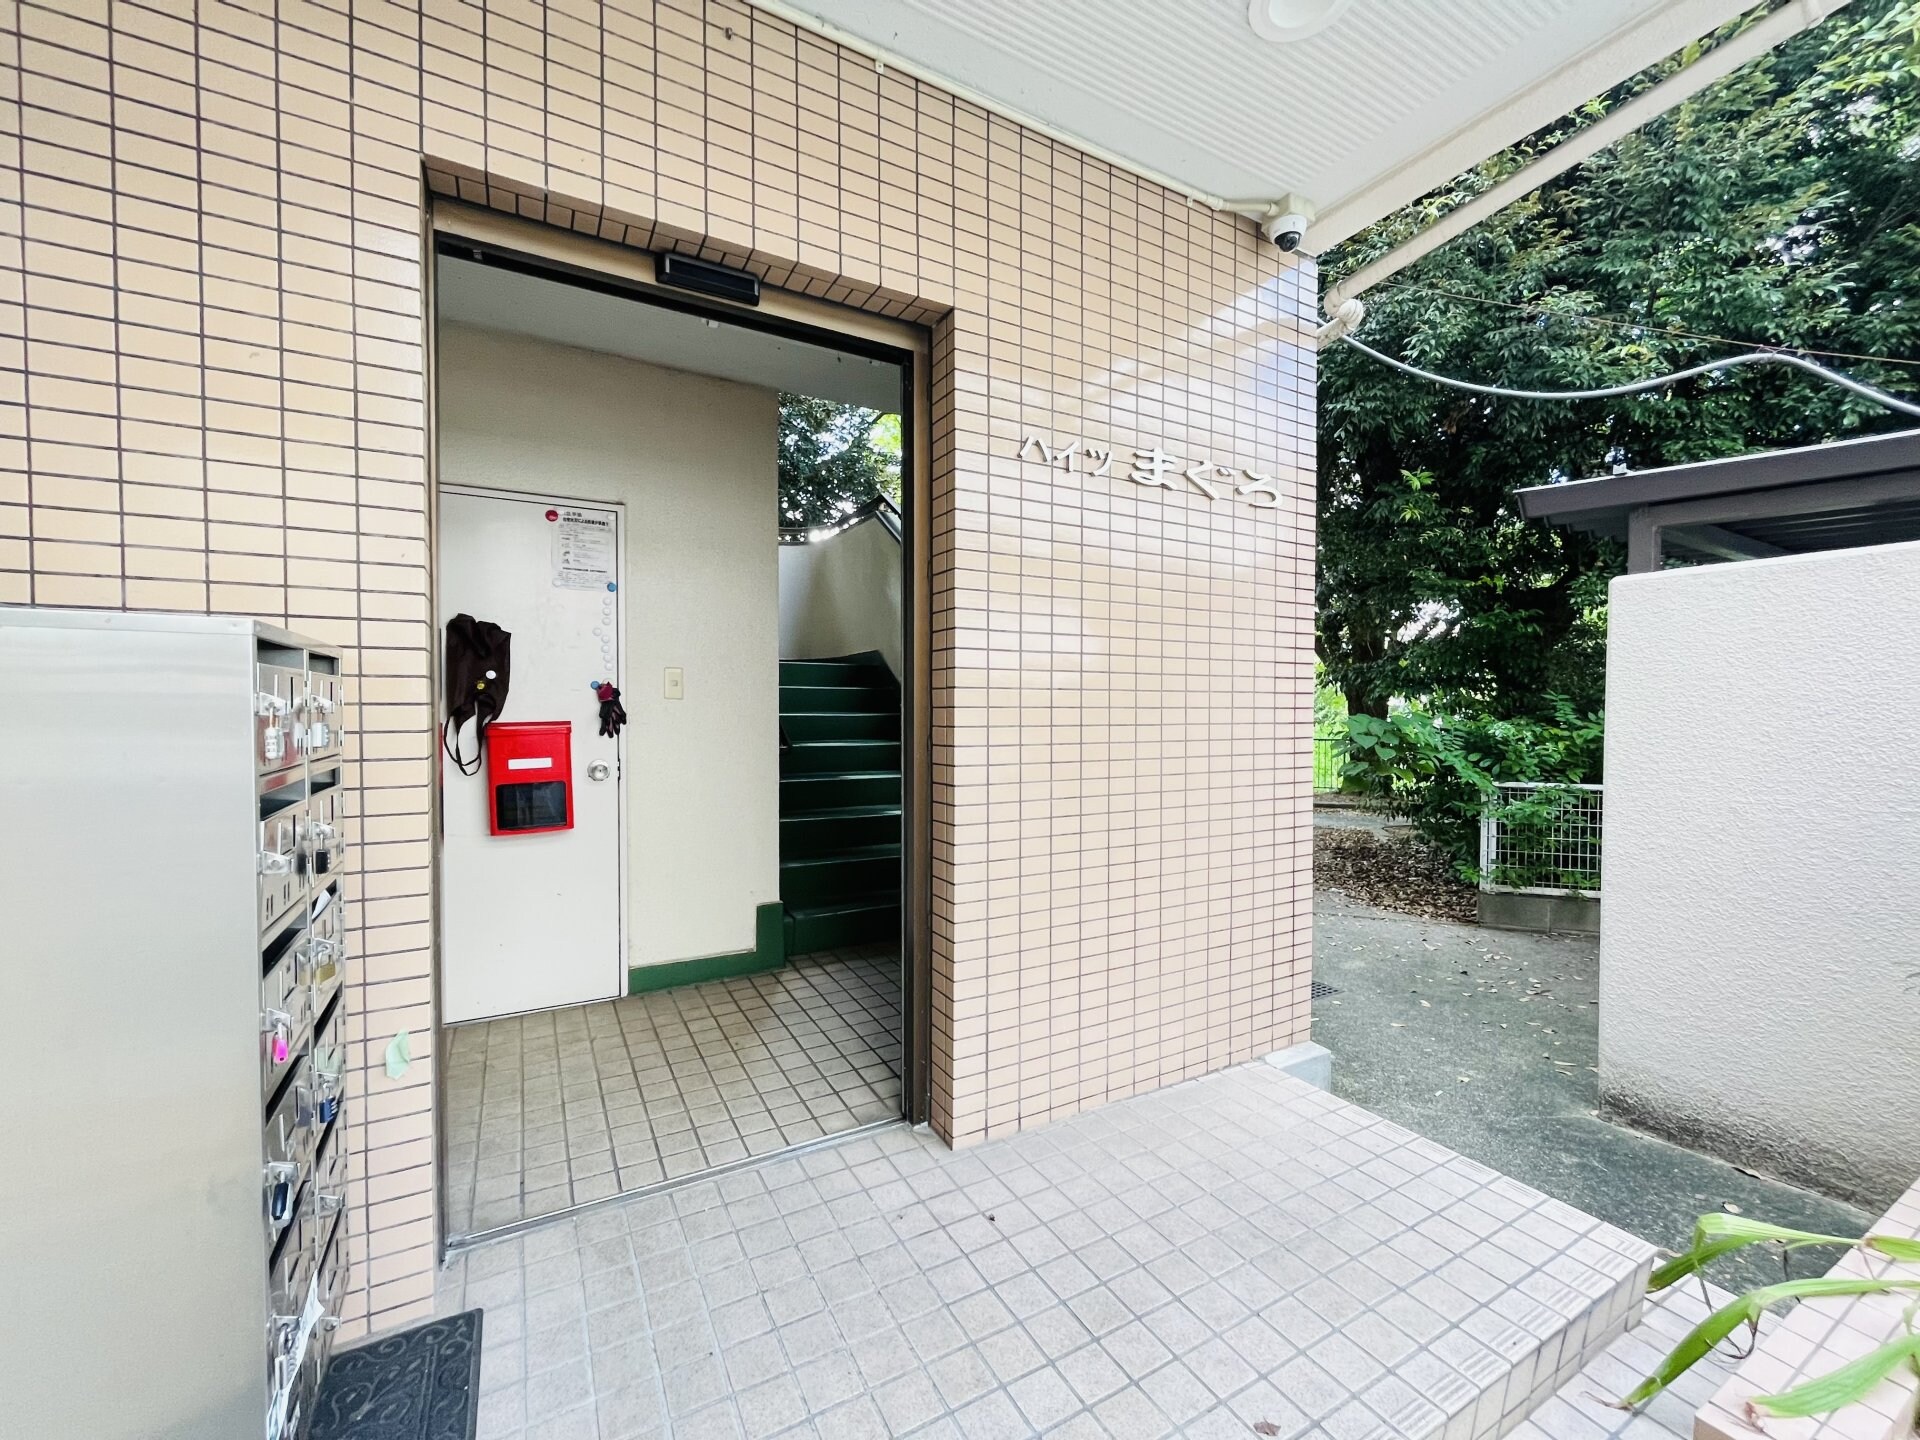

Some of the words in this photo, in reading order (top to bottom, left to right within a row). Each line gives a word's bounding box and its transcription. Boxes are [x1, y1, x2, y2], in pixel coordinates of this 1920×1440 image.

[1018, 436, 1113, 477] ハイツ
[1128, 447, 1284, 508] まぐろ
